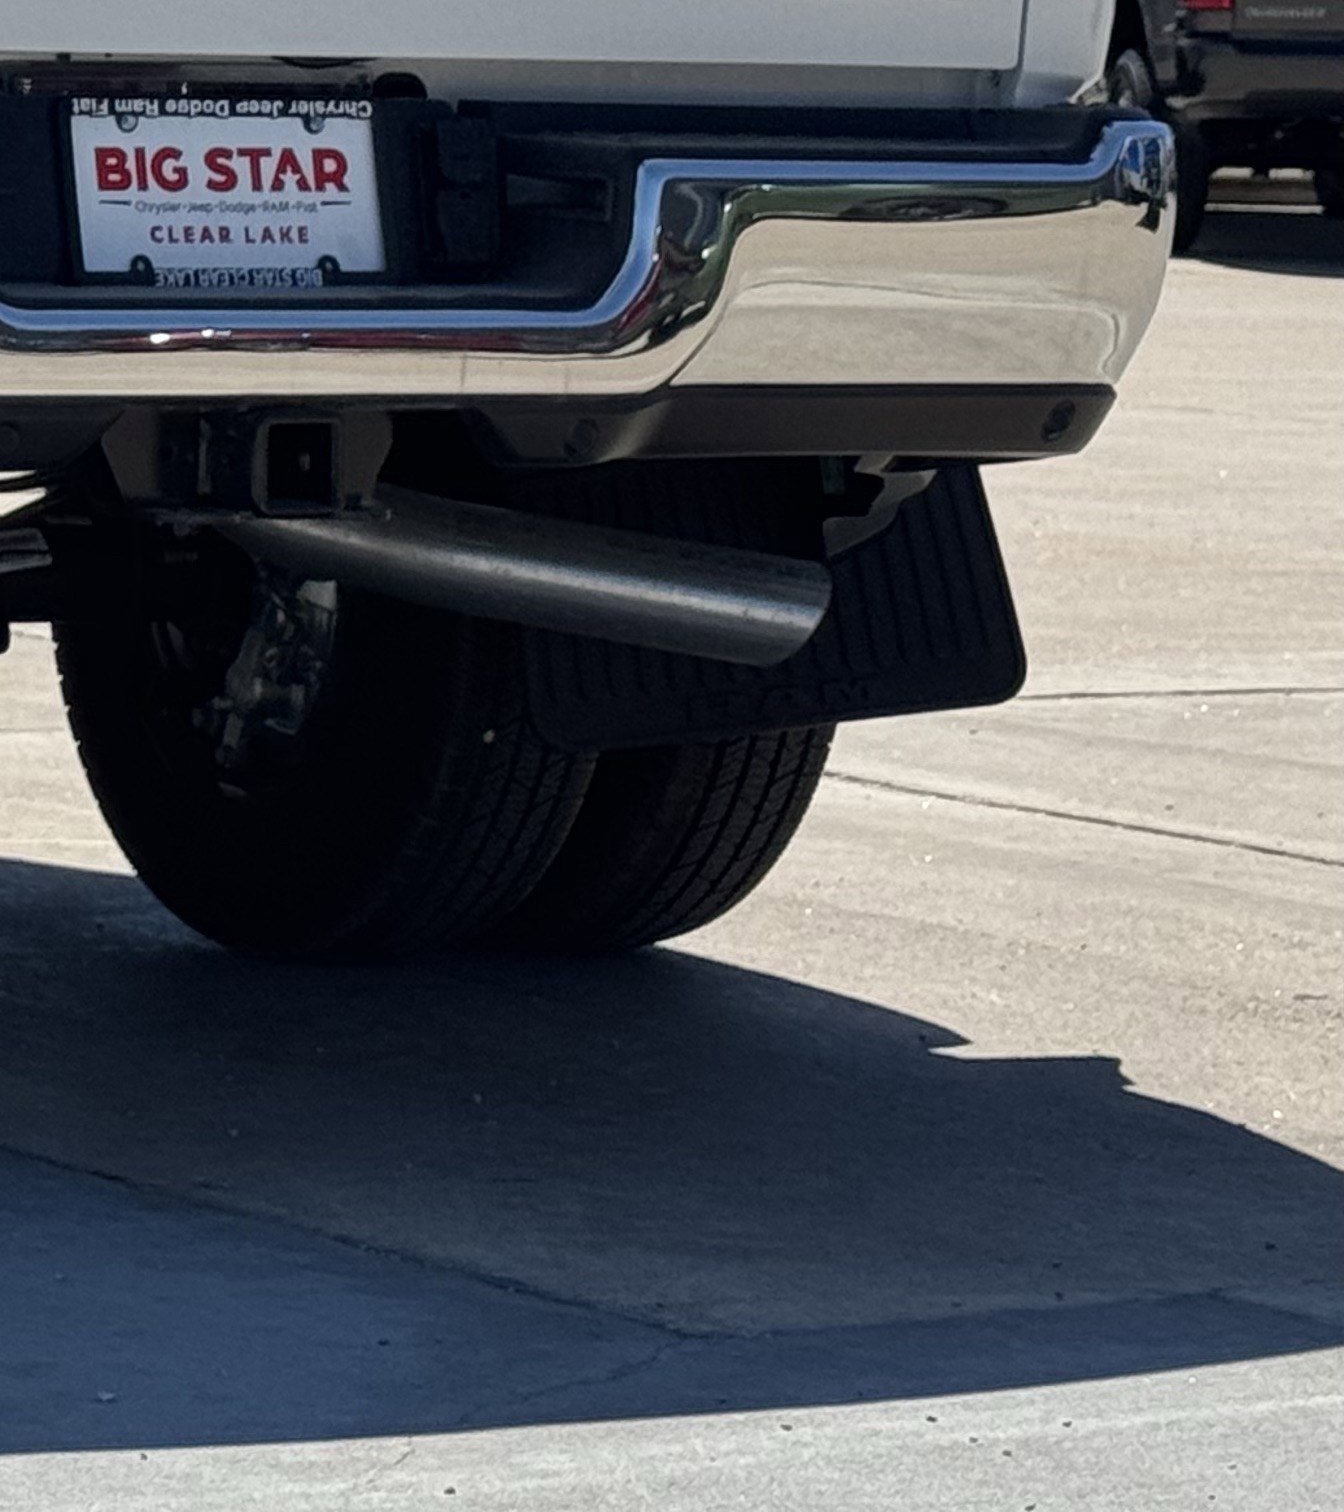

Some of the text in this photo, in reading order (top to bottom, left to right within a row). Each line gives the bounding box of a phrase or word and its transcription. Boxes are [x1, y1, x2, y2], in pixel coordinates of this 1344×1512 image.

[71, 97, 373, 118] Chrysler Jeep Dodge Ram Fiat
[94, 145, 350, 193] BIG STAR
[149, 225, 310, 245] CLEAR LAKE
